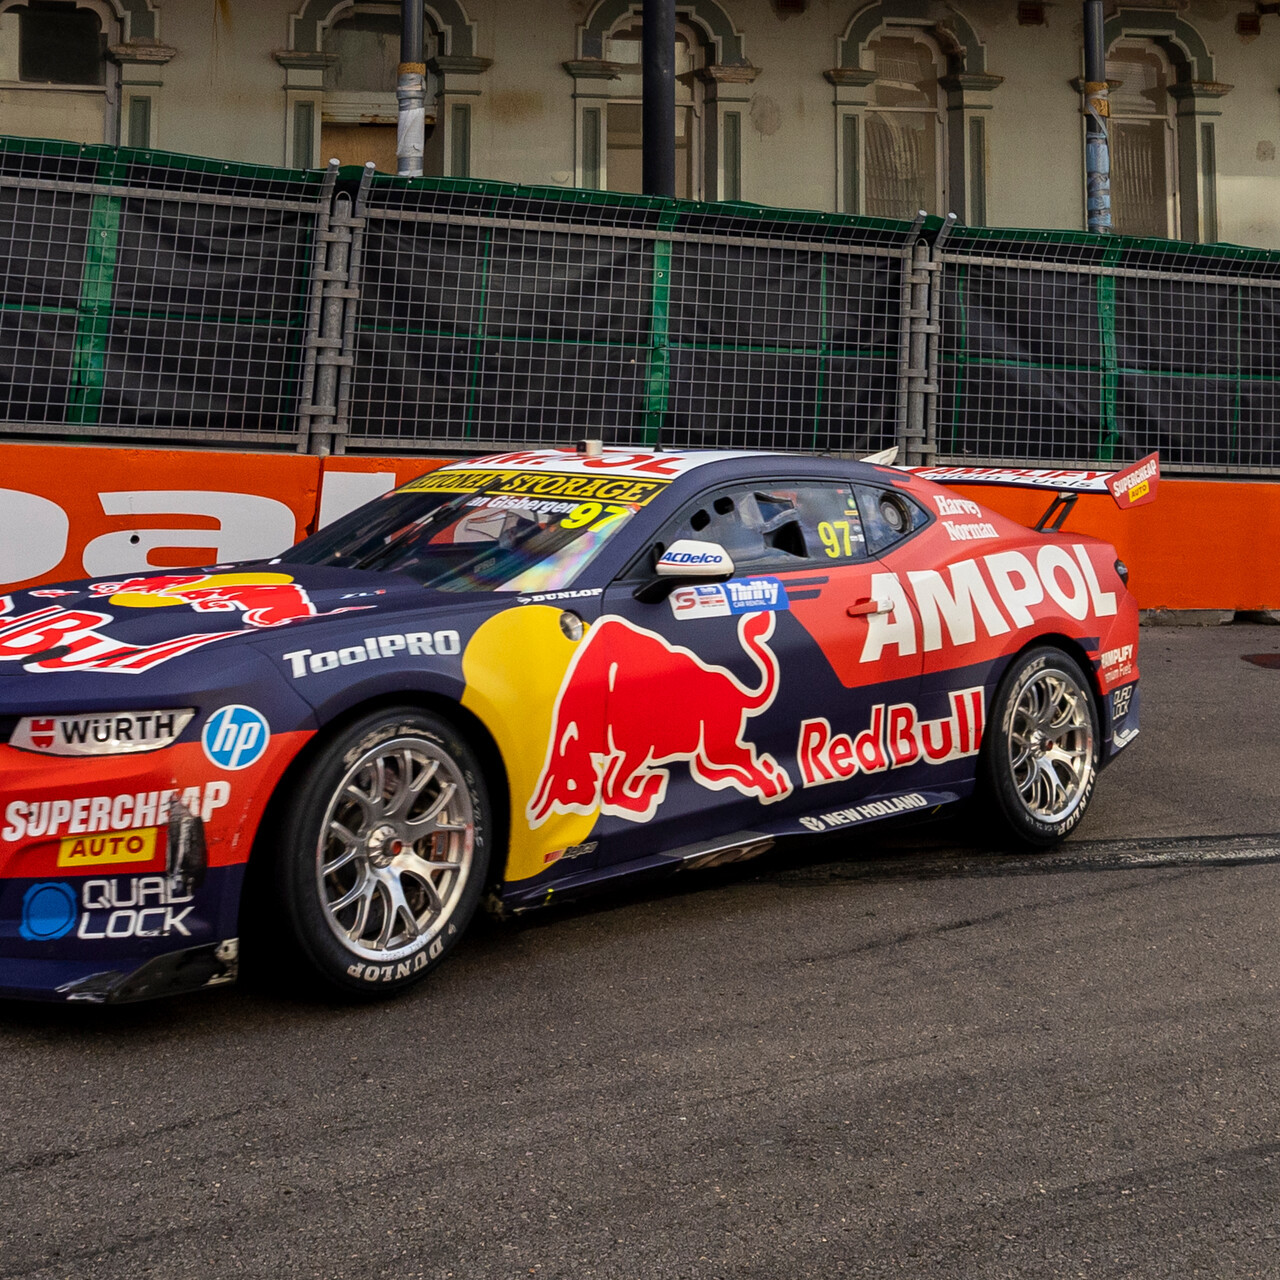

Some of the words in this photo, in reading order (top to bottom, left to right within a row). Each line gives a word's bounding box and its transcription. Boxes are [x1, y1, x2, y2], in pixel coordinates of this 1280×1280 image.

[500, 474, 651, 502] STORAGE
[1011, 476, 1096, 488] Fuels
[1112, 458, 1158, 498] SUPERCHEAP
[1130, 483, 1148, 499] AUTO
[486, 494, 580, 515] Gisbergen
[560, 502, 632, 533] 97
[933, 495, 982, 518] Harvey
[818, 521, 852, 558] 97
[942, 521, 1000, 542] Norman
[661, 552, 722, 564] ACDelco
[532, 588, 603, 603] DUNLOP
[726, 580, 779, 605] Thrifty
[859, 544, 1117, 663] AMPOL
[282, 630, 462, 678] ToolPRO
[1113, 685, 1133, 705] QUAD
[211, 706, 261, 769] hp
[1, 780, 232, 843] SUPERCHEAP
[825, 808, 859, 827] NEW
[860, 793, 928, 821] HOLLAND
[68, 836, 144, 858] AUTO
[77, 905, 196, 939] LOCK
[346, 934, 444, 982] DUNLOP
